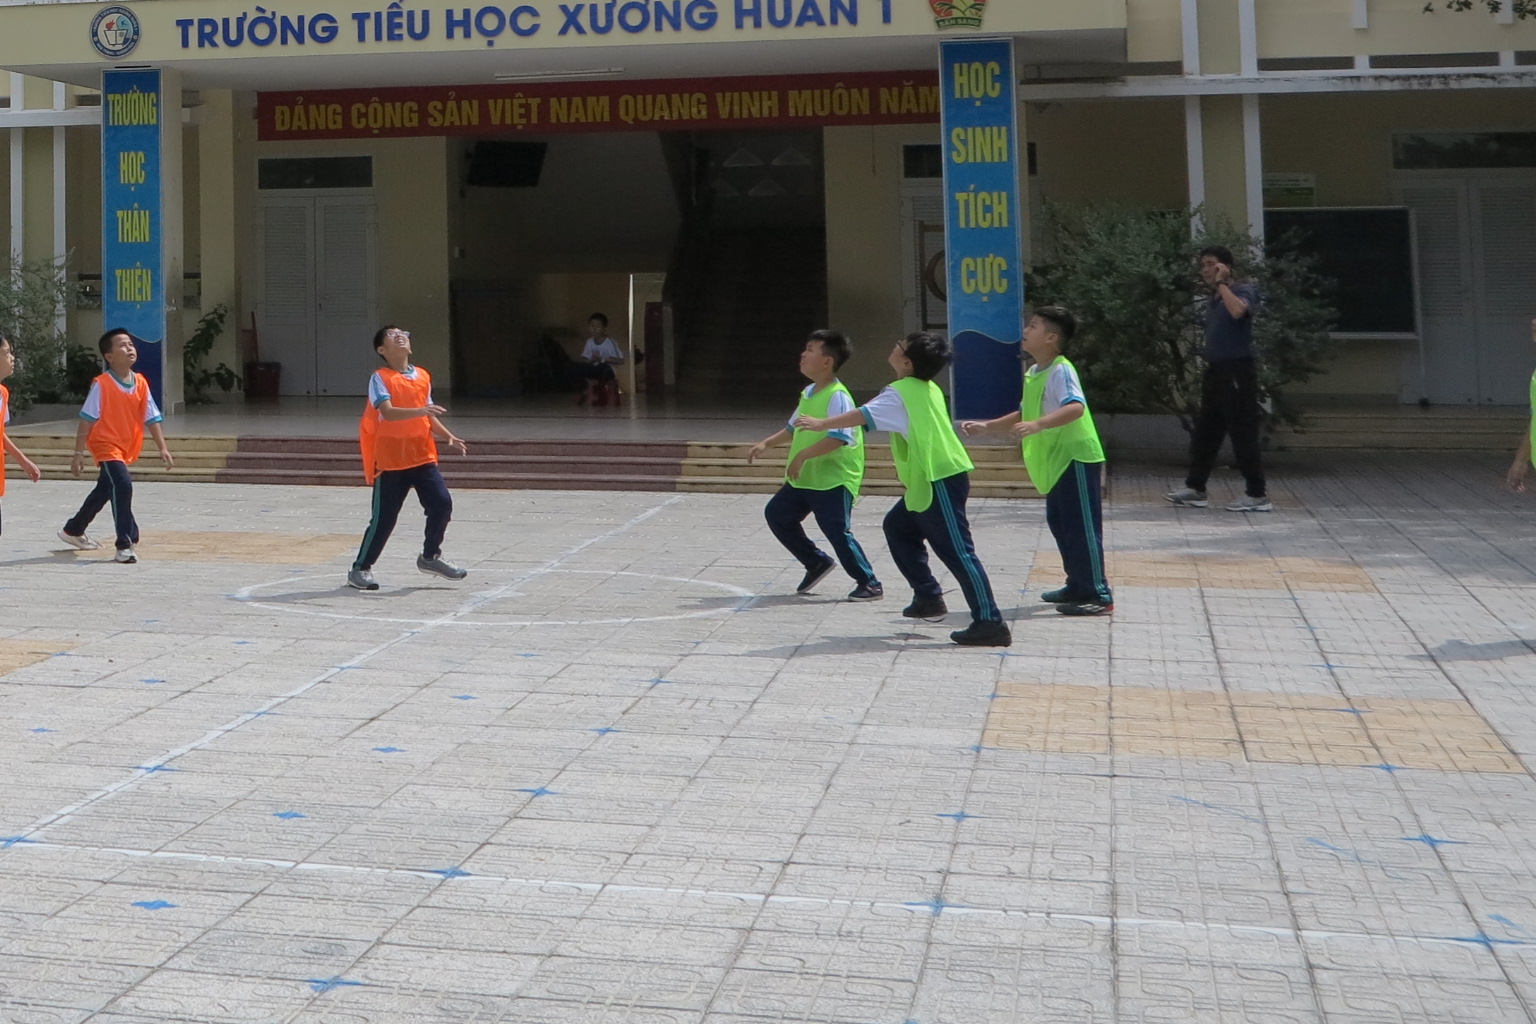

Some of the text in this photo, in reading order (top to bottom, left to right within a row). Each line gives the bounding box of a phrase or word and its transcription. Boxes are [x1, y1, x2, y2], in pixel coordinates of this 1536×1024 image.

[176, 5, 339, 49] TRƯỜNG
[445, 5, 542, 47] HỌC
[107, 84, 157, 126] TRƯỜNG
[953, 61, 1001, 107] HỌC
[274, 80, 940, 134] ĐẢNG CỘNG SẢN VIỆT NAM QUANG VINH MUÔN NĂM
[951, 127, 1008, 163] SINH
[119, 151, 145, 192] HỌC
[117, 203, 150, 243] THÂN
[955, 184, 1008, 228] TÍCH
[115, 262, 152, 309] THIỆN
[960, 253, 1008, 302] CỰC
